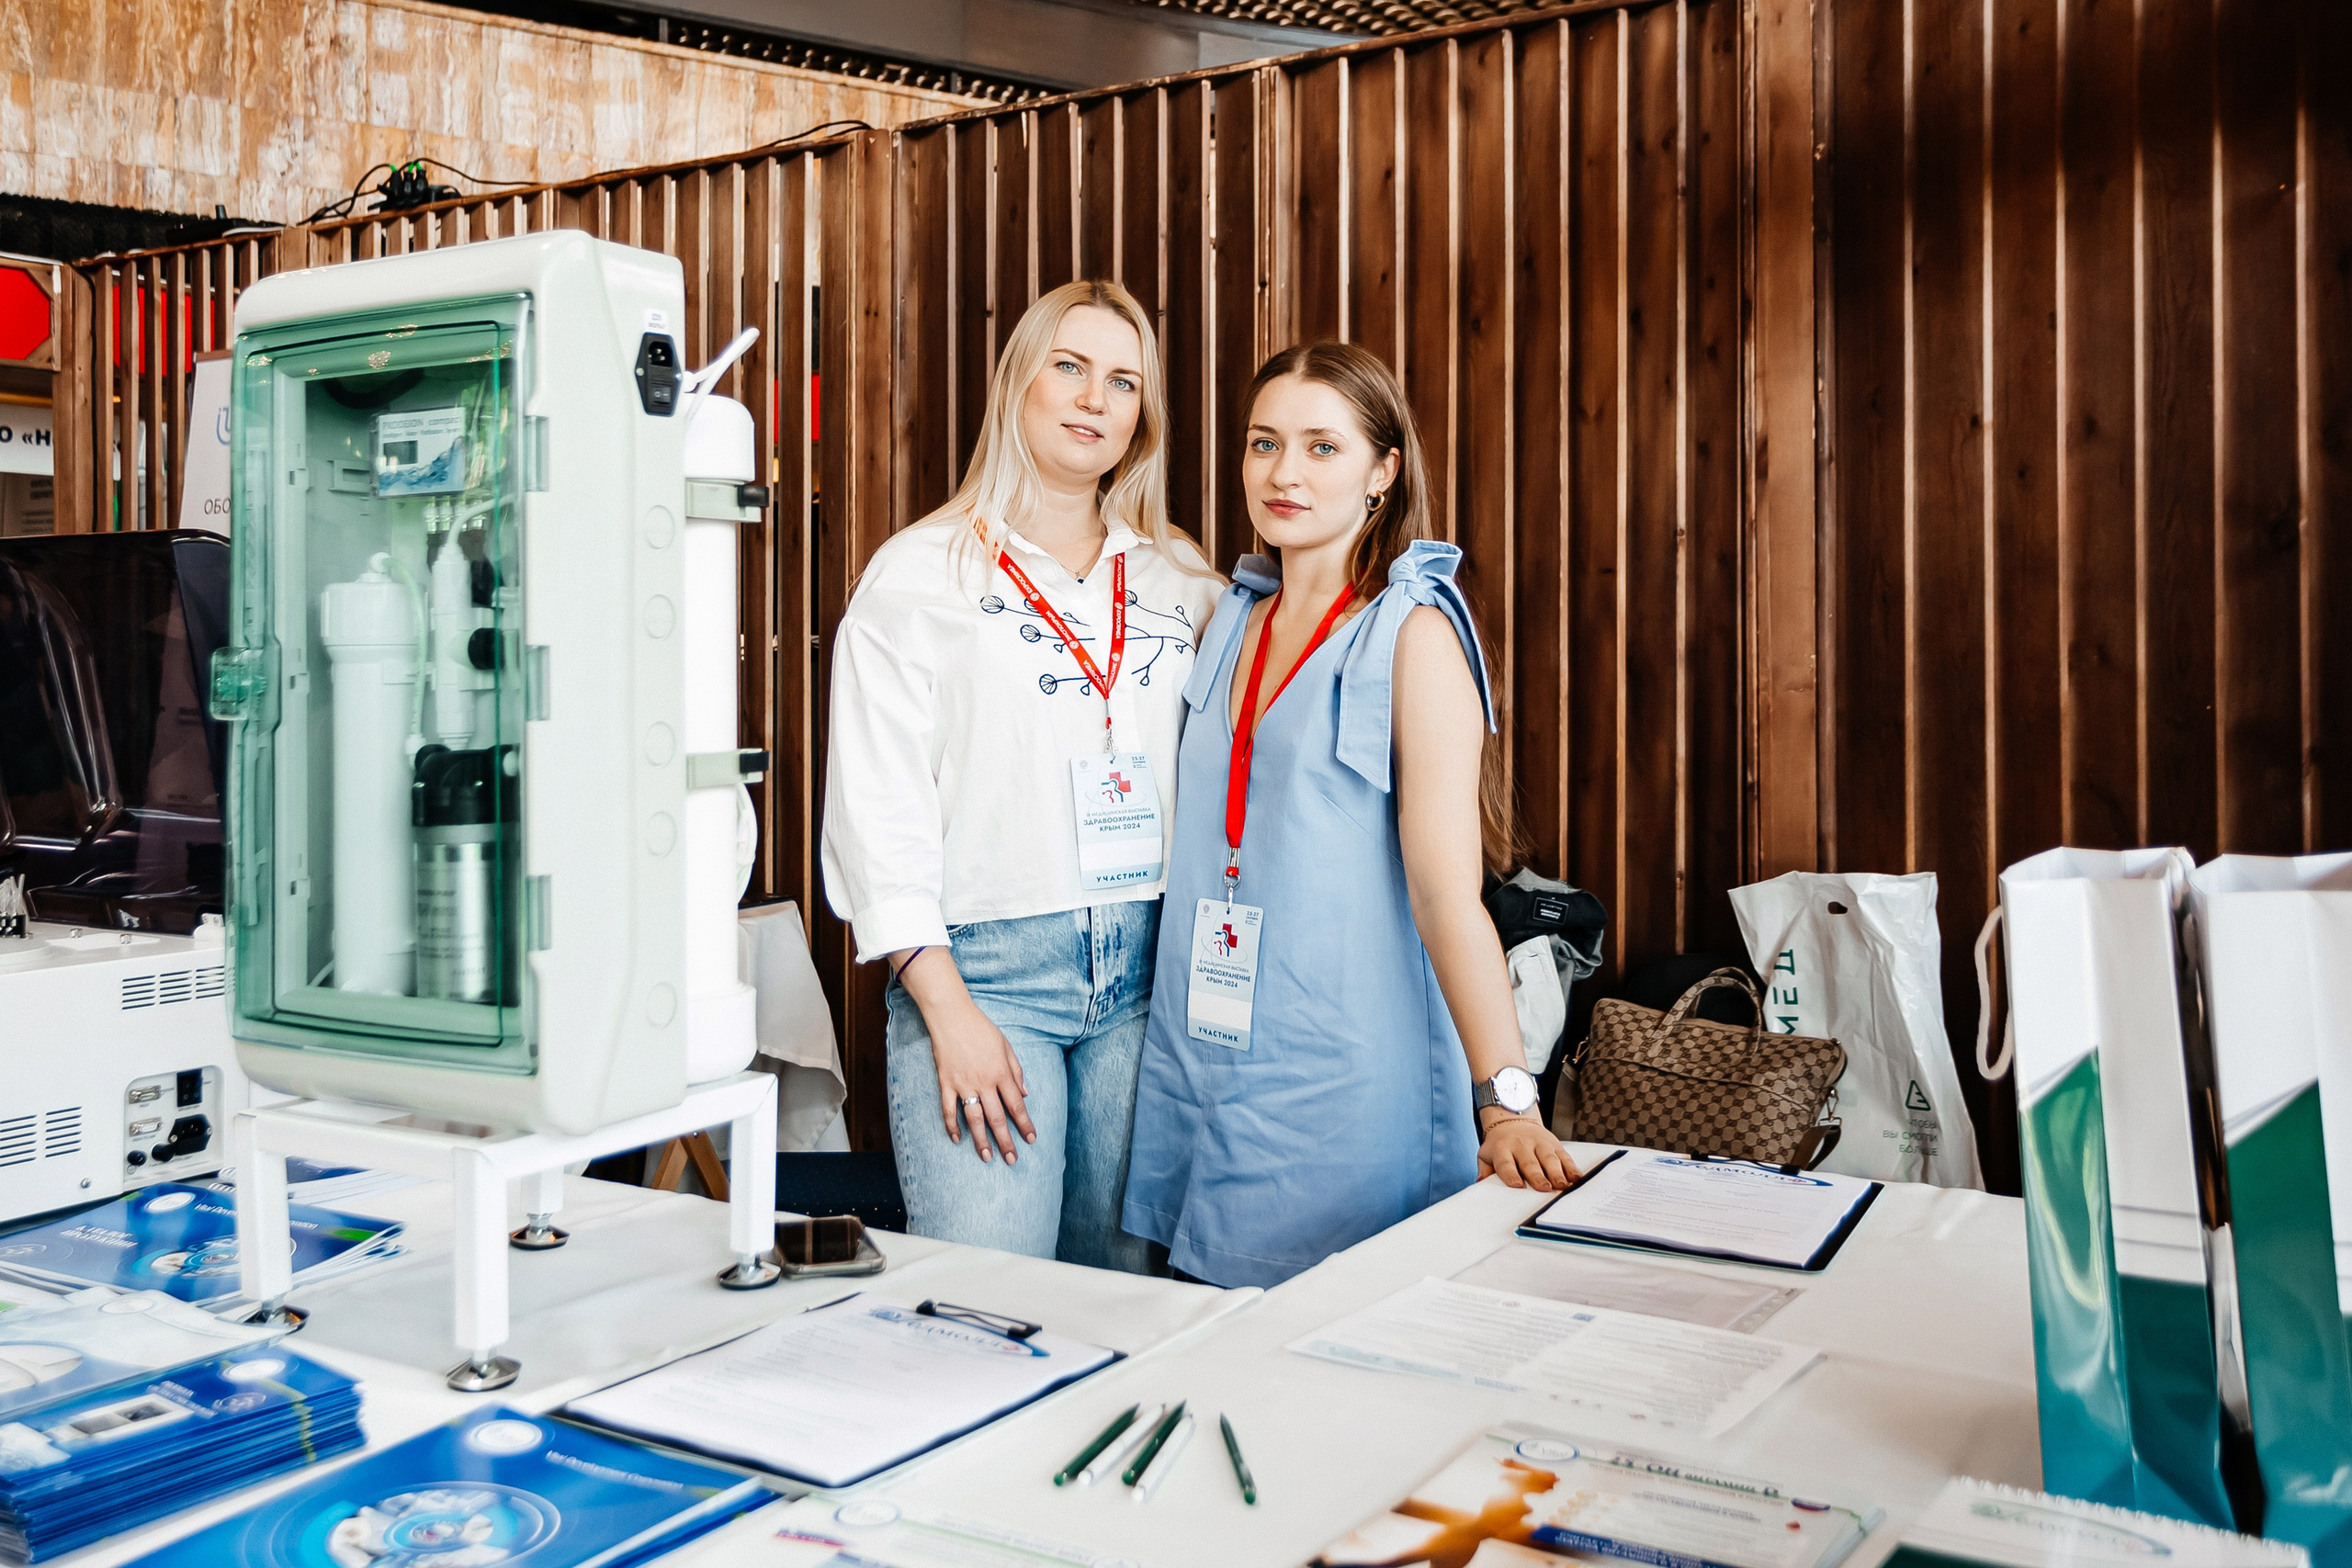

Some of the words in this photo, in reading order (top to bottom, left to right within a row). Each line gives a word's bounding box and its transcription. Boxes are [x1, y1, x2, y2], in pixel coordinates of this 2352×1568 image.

[1083, 813, 1156, 826] ЗДРАВООХРАНЕНИЕ
[1099, 824, 1121, 832] КРЫМ
[1123, 822, 1141, 830] 2024
[1096, 870, 1148, 883] УЧАСТНИК
[1195, 964, 1250, 983] ЗДРАВООХРАНЕНИЕ
[1205, 976, 1223, 986] КРЫМ
[1224, 979, 1238, 988] 2024
[1198, 1026, 1238, 1043] УЧАСТНИК
